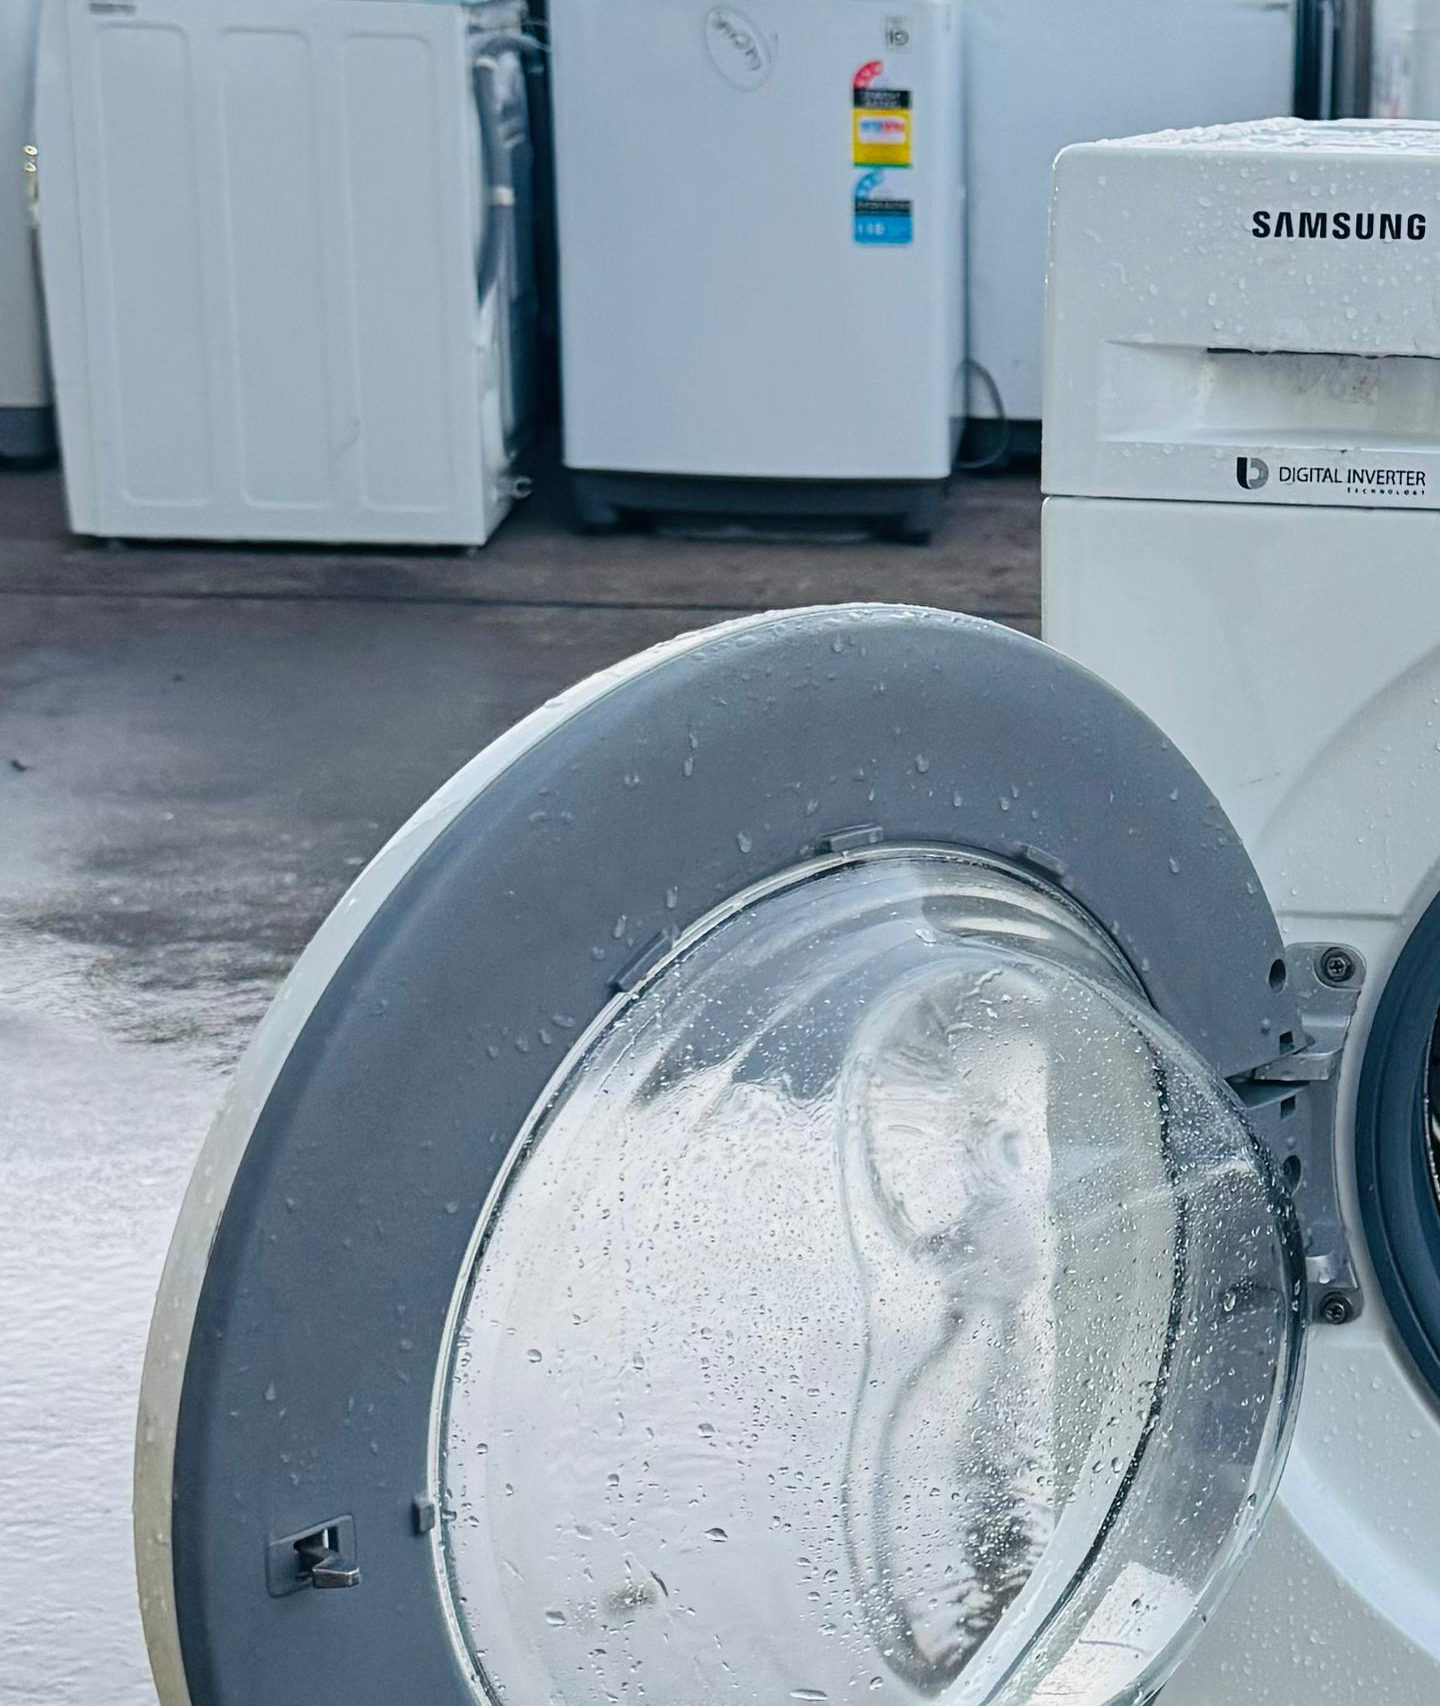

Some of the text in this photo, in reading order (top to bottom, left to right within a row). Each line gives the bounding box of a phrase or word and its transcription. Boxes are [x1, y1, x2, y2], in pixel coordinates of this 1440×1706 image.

[1252, 210, 1427, 240] SAMSUNG
[1279, 466, 1426, 486] DIGITAL INVERTER
